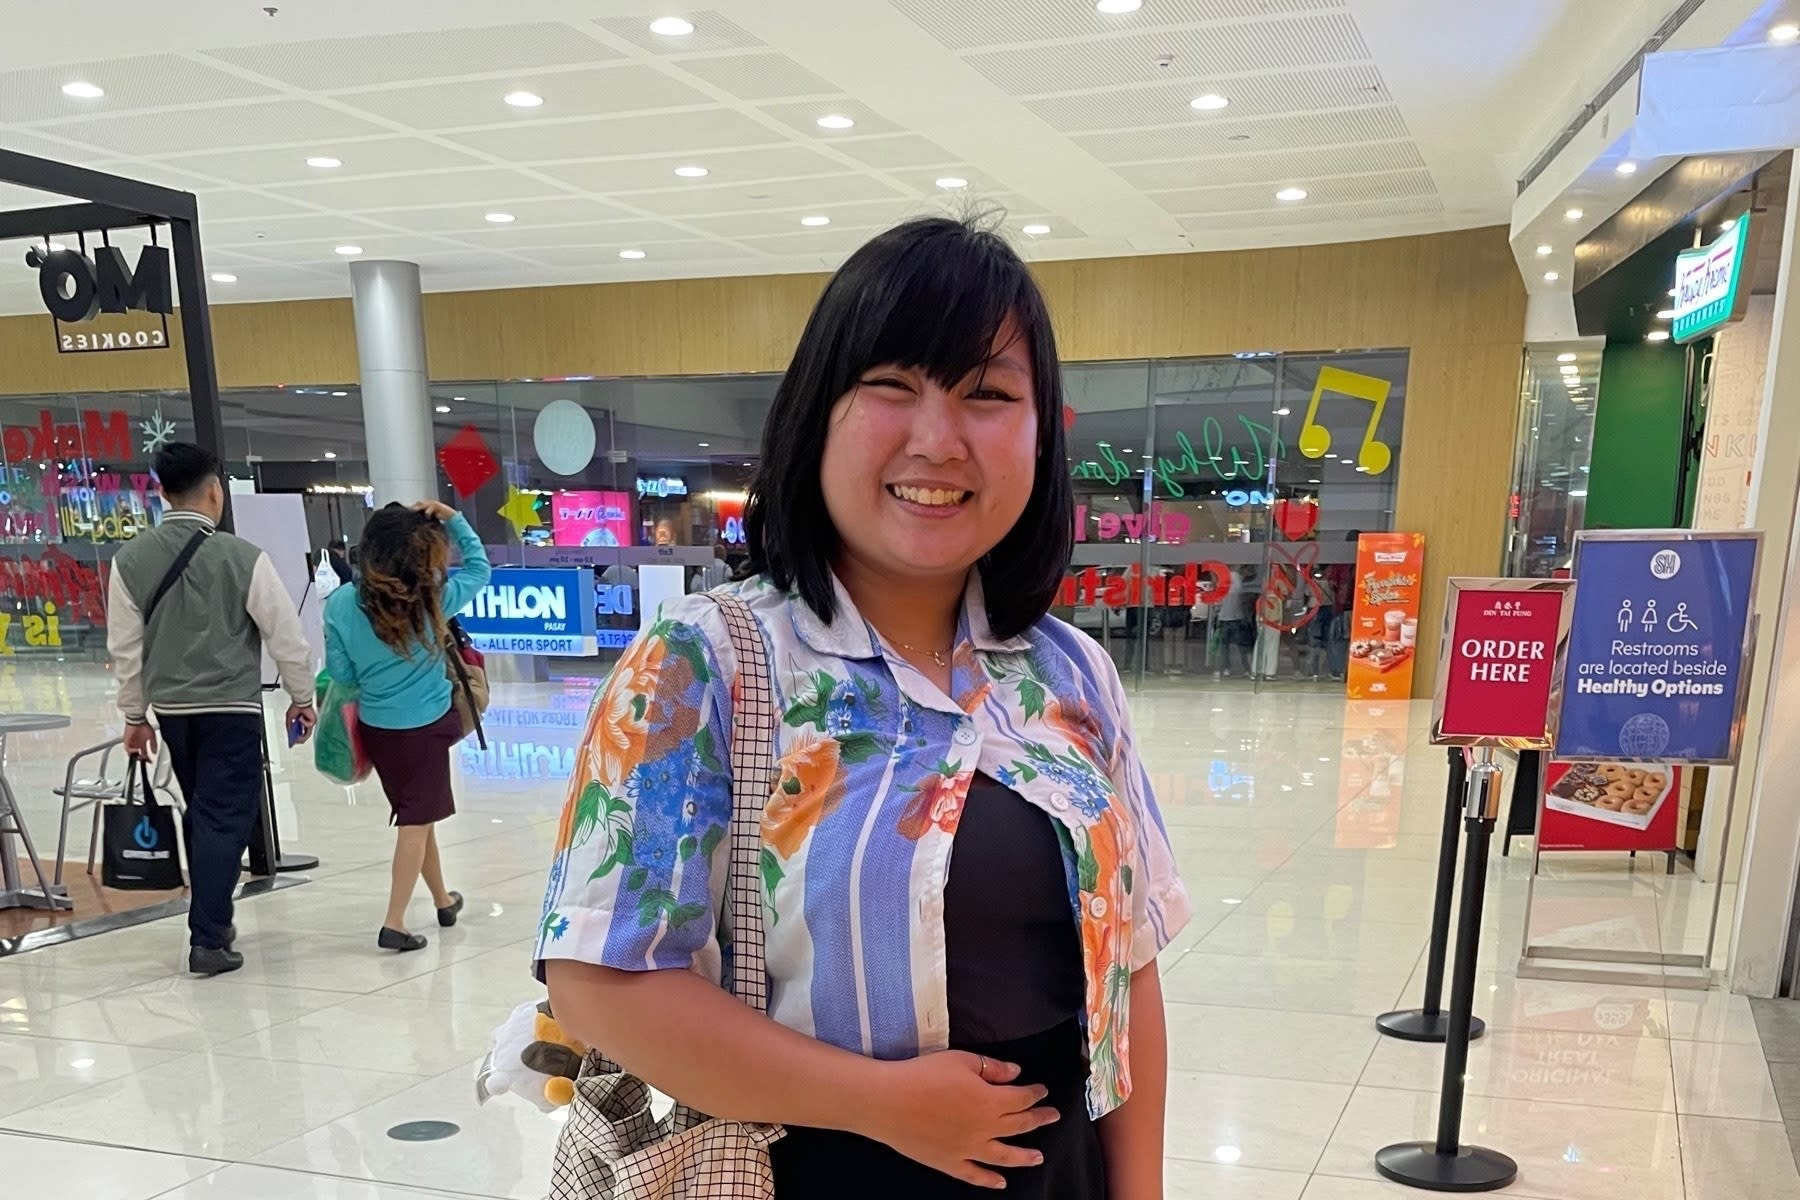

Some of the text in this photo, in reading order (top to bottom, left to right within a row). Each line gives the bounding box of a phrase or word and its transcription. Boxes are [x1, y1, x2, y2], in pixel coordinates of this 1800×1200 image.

[544, 622, 567, 631] PASAY
[489, 638, 509, 650] ALL
[511, 639, 536, 651] FOR
[536, 639, 572, 651] SPORT
[1461, 639, 1545, 660] ORDER
[1611, 640, 1699, 656] Restrooms
[1470, 662, 1531, 683] HERE
[1579, 660, 1727, 676] are located beside
[1577, 678, 1724, 698] Healthy Options
